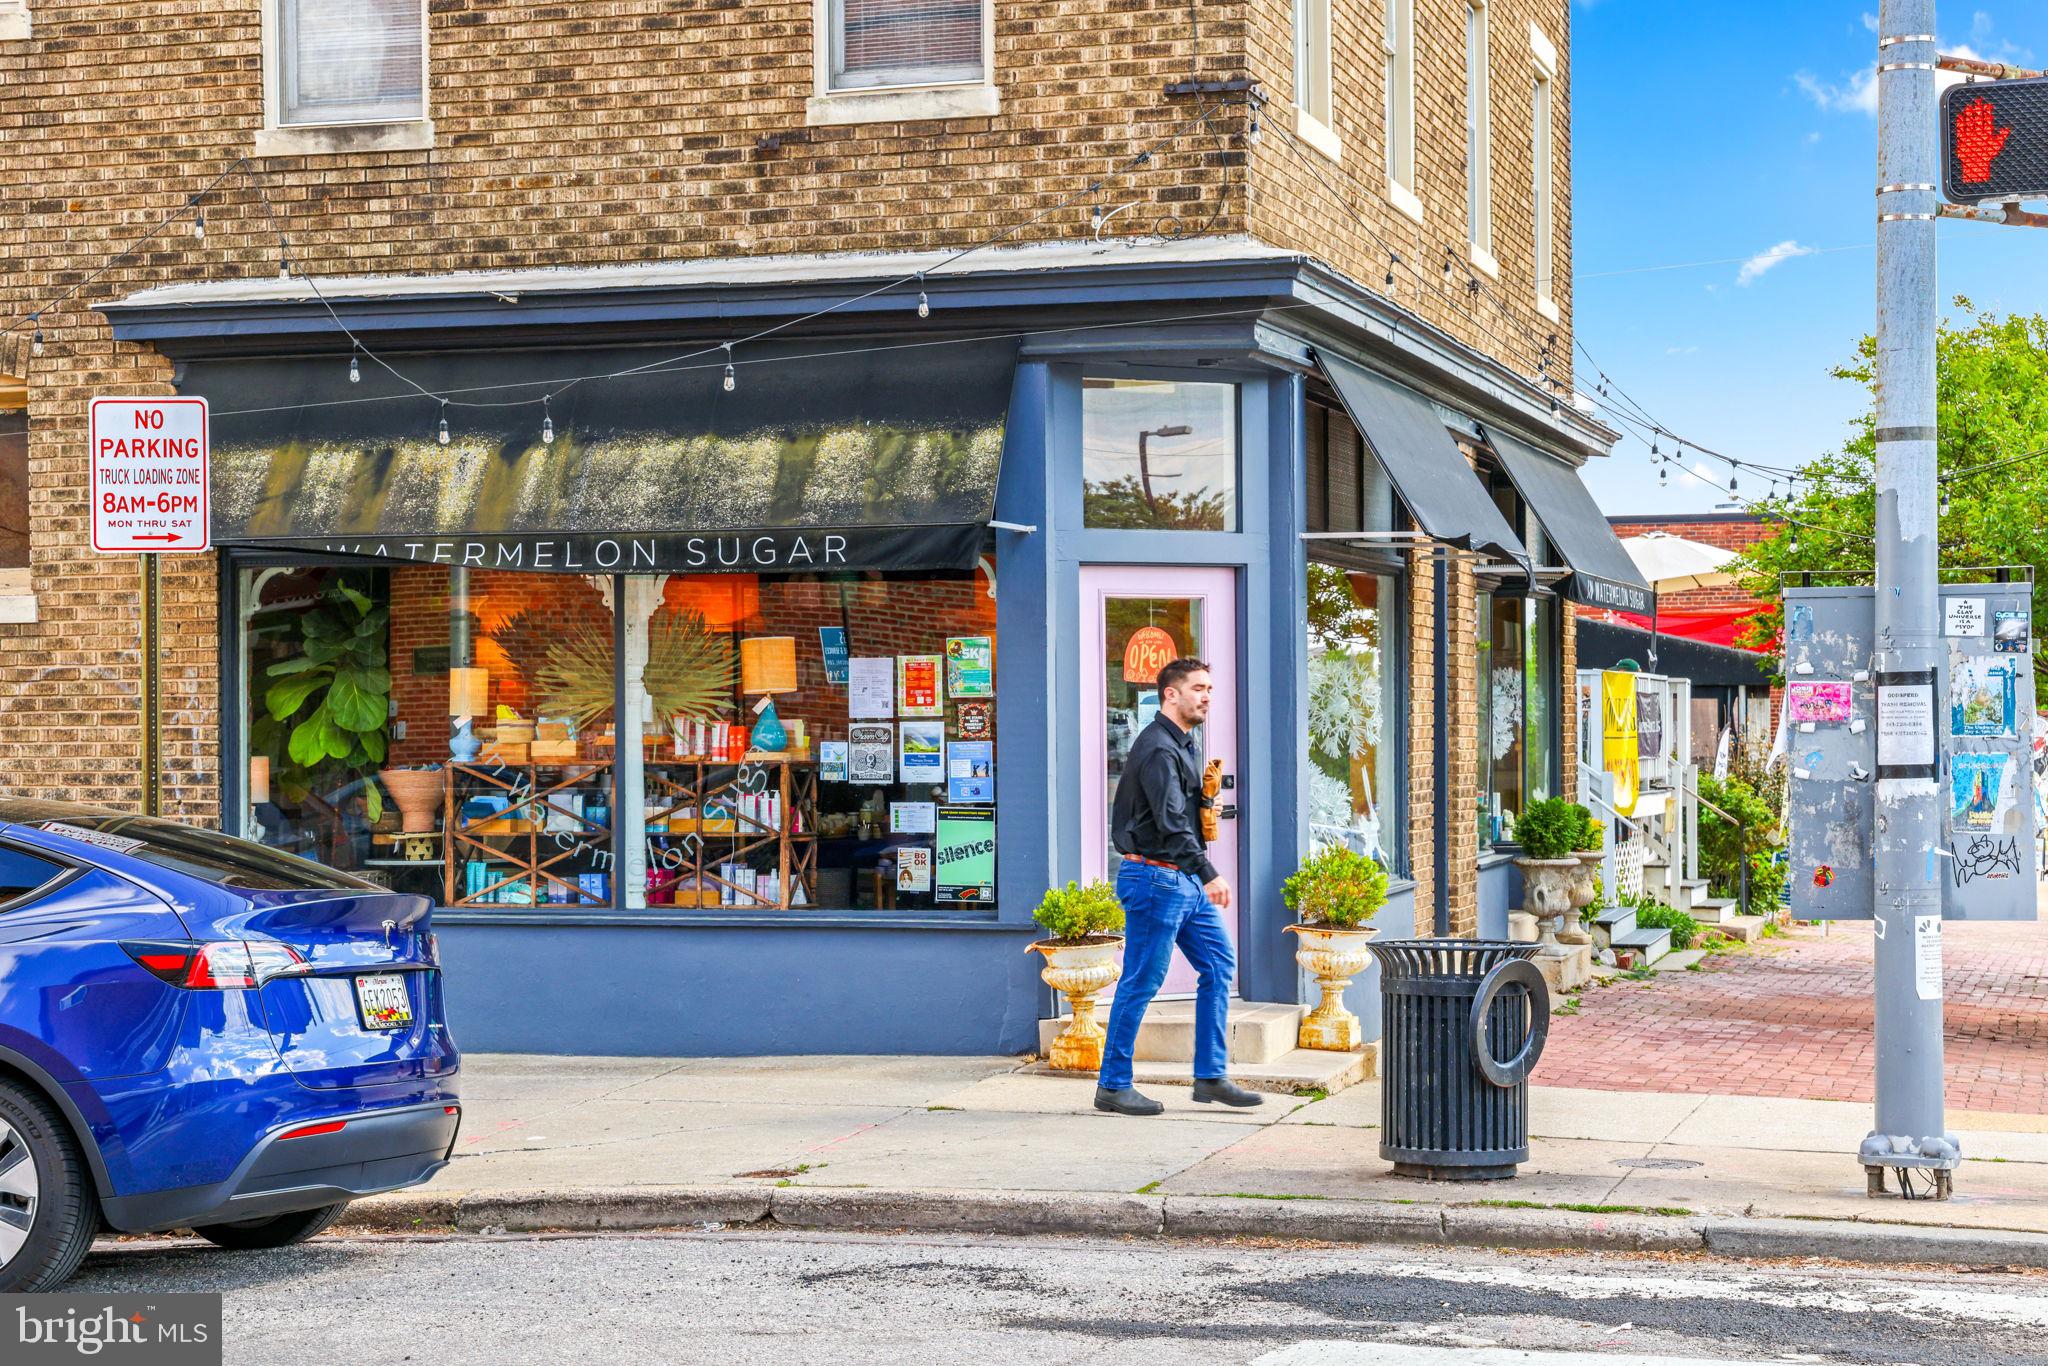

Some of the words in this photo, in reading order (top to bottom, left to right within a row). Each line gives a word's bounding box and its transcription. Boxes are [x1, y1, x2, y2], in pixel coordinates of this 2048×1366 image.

[135, 409, 164, 429] NO
[100, 438, 199, 458] PARKING
[100, 468, 130, 485] TRUCK
[133, 468, 172, 485] LOADING
[176, 468, 200, 485] ZONE
[102, 492, 198, 513] 8AM-6PM
[108, 519, 133, 528] MON
[137, 519, 167, 528] THRU
[171, 519, 193, 528] SAT
[687, 535, 848, 566] SUGAR
[1594, 581, 1629, 607] WATERMELON
[1629, 588, 1645, 610] SUGAR
[1131, 644, 1170, 672] OPEN
